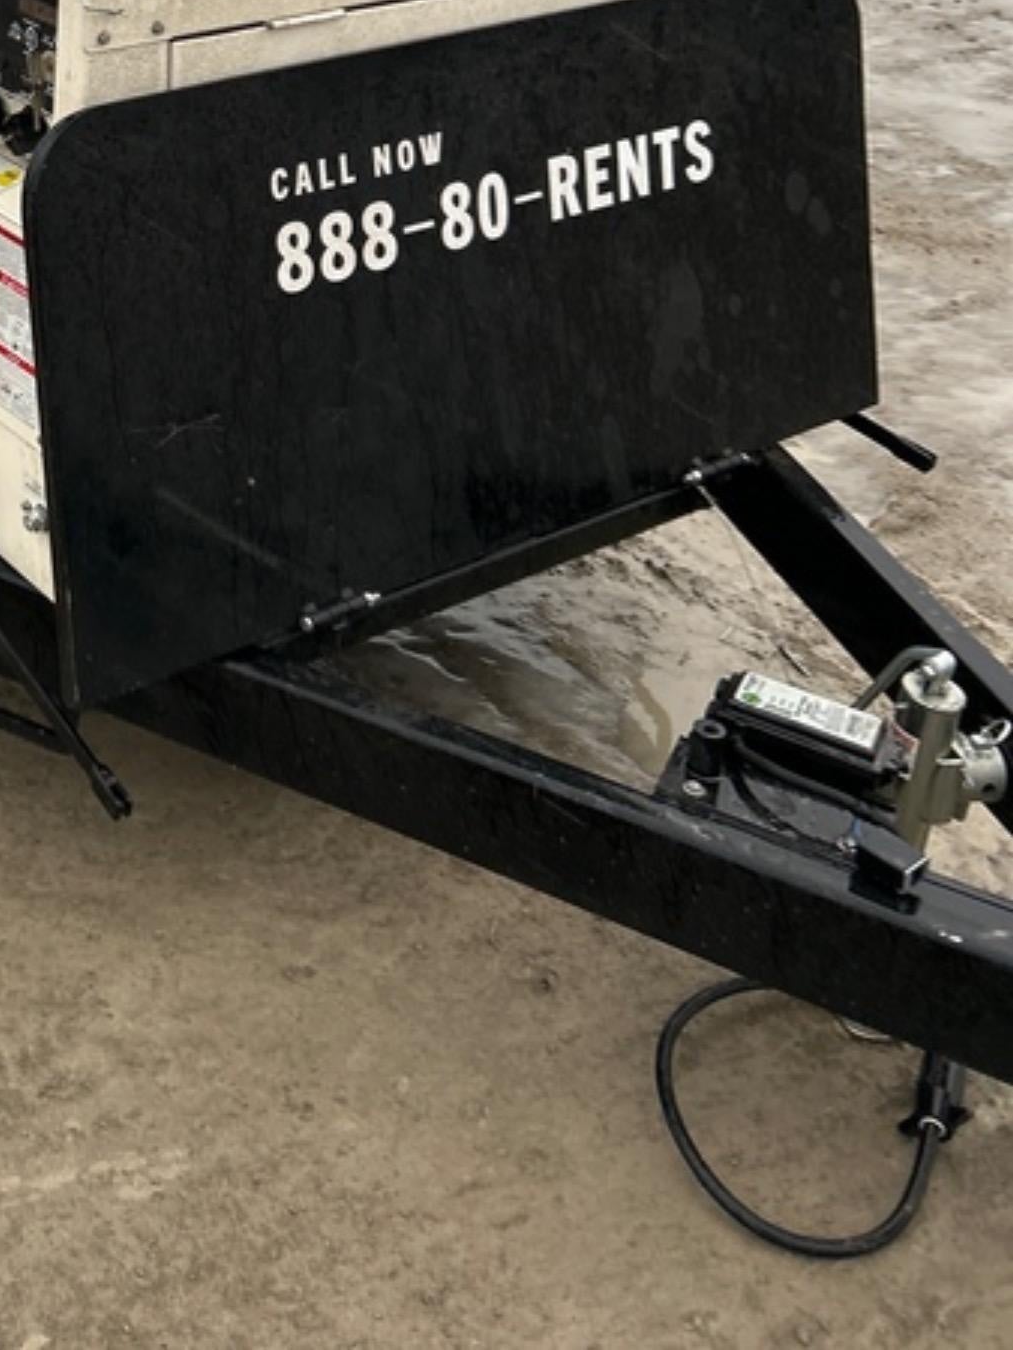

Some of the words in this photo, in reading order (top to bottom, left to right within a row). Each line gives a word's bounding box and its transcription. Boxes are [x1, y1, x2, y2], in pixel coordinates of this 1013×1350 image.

[271, 154, 357, 200] CALL
[373, 131, 443, 177] NOW
[276, 120, 714, 293] 888-80-RENTS
